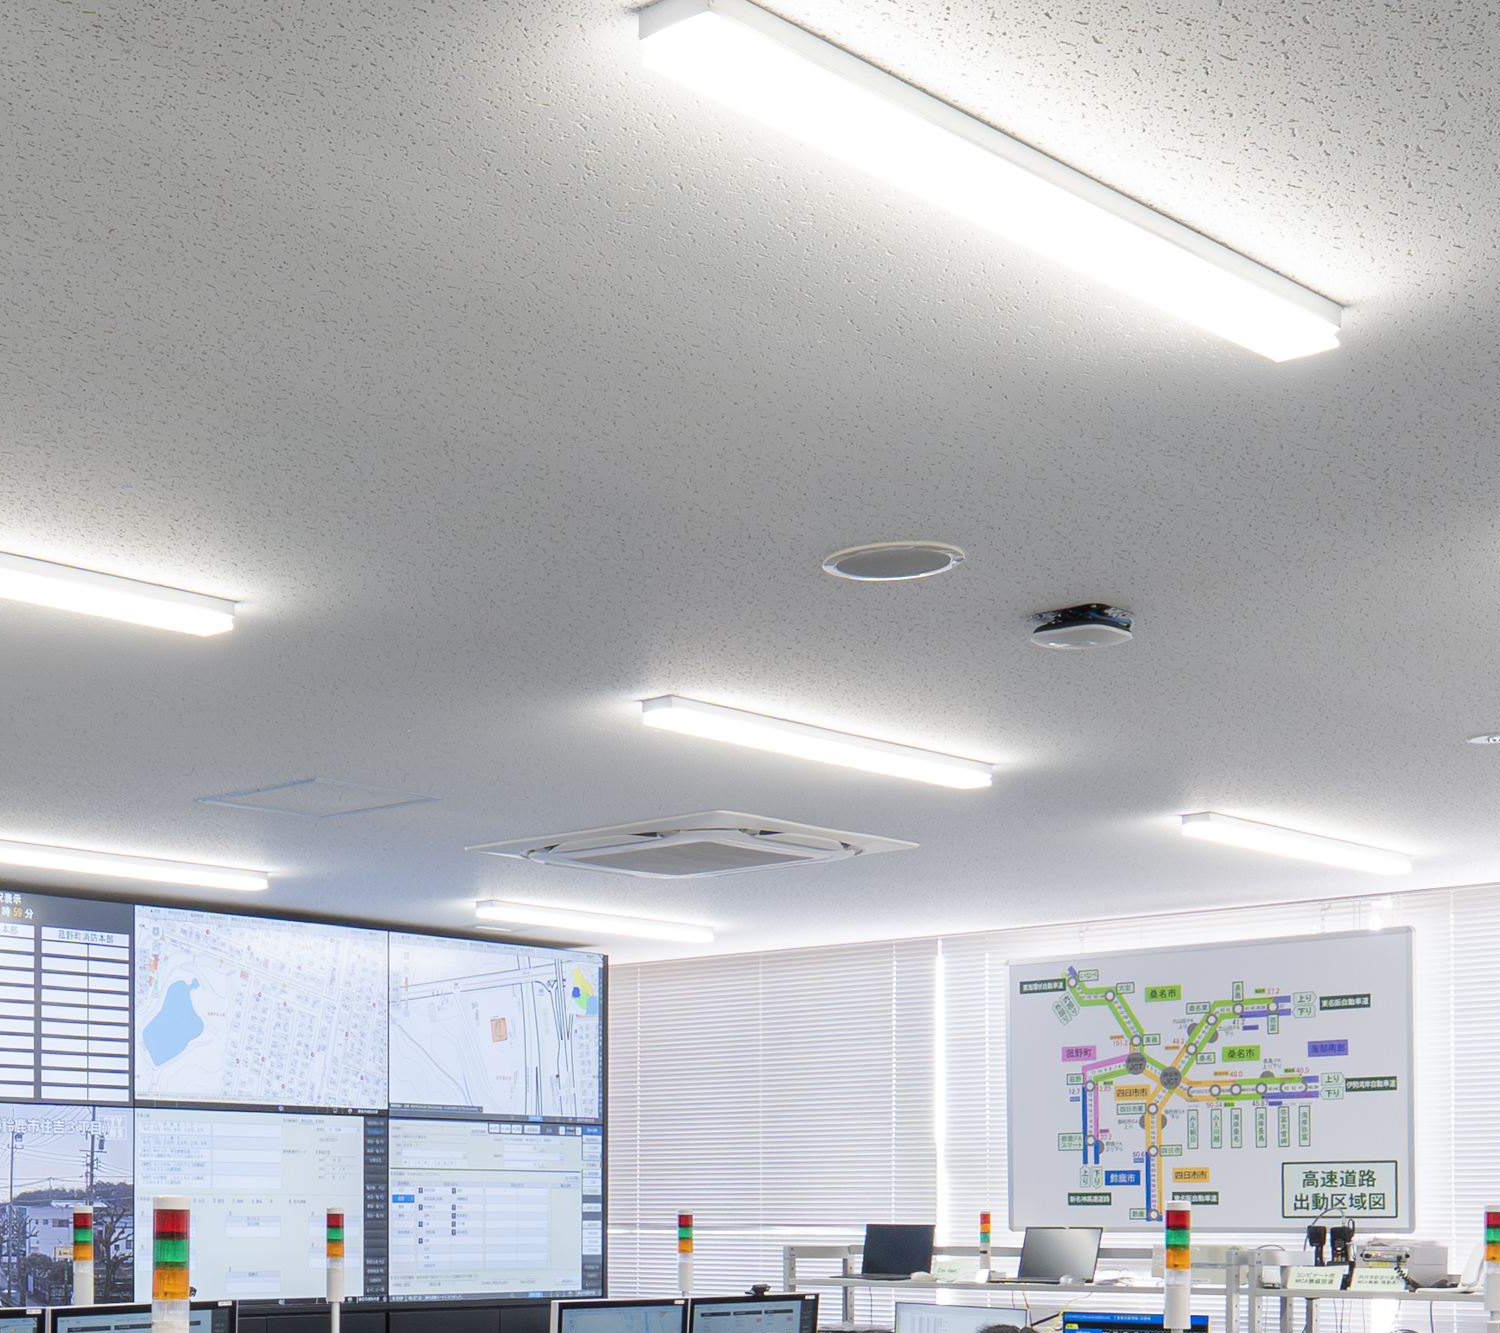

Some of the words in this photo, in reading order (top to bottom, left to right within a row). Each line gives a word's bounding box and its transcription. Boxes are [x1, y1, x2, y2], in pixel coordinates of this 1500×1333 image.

[1150, 989, 1177, 998] 桑名市
[1228, 1049, 1255, 1058] 桑名市
[1325, 1075, 1339, 1083] 上り
[1117, 1089, 1147, 1097] 四日市市
[1325, 1089, 1340, 1097] 下り
[1302, 1170, 1376, 1188] 高速道路
[1293, 1193, 1386, 1211] 出動区域図
